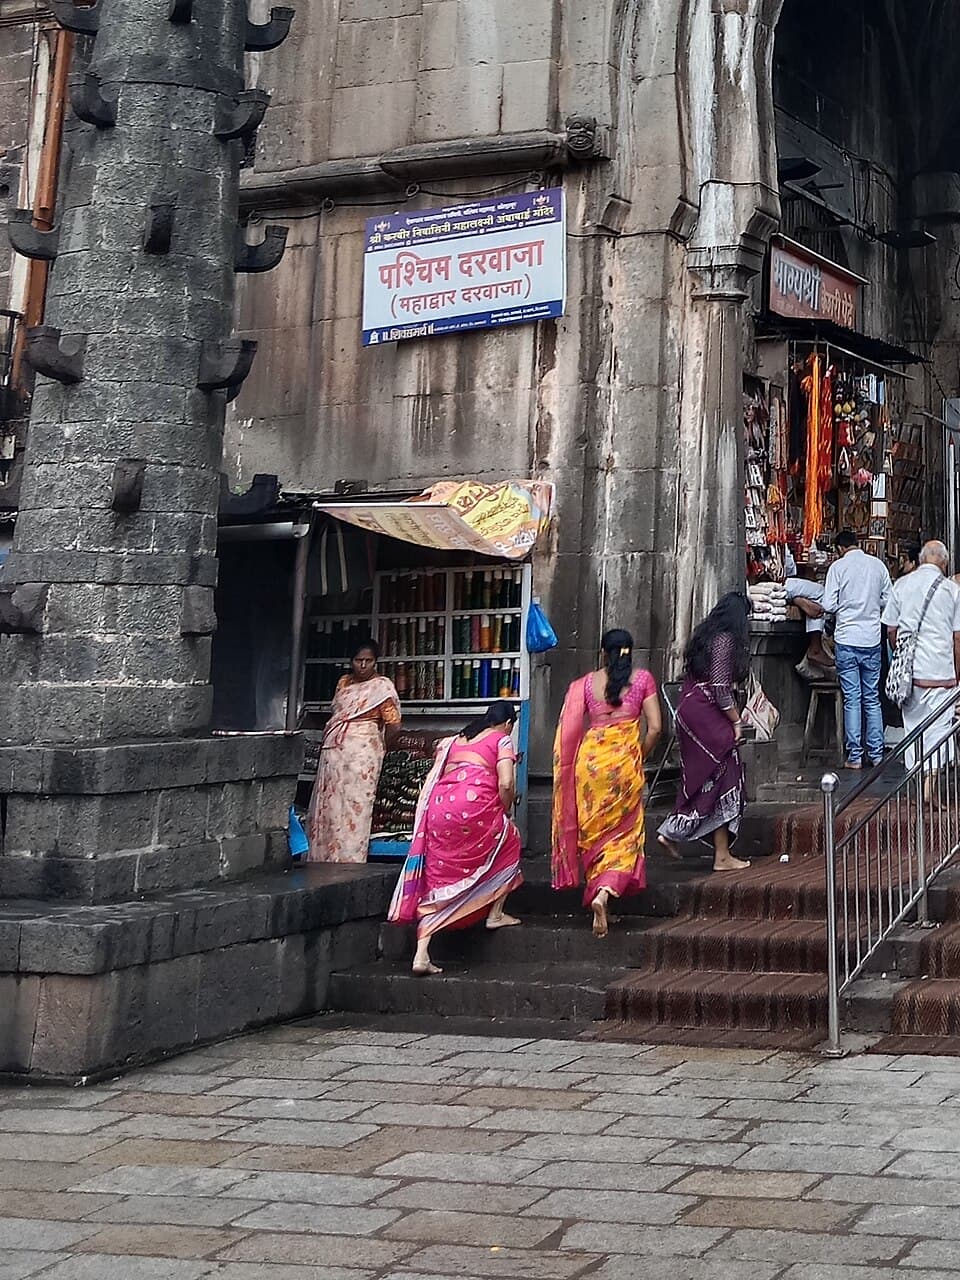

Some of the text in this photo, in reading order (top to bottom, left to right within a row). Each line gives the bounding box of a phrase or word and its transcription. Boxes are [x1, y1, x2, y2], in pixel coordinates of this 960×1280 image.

[378, 239, 545, 291] पश्चिम दरवाजा
[774, 252, 822, 311] भाग्यश्री
[390, 288, 456, 319] (महाद्वार
[460, 272, 532, 303] दरवाजा)
